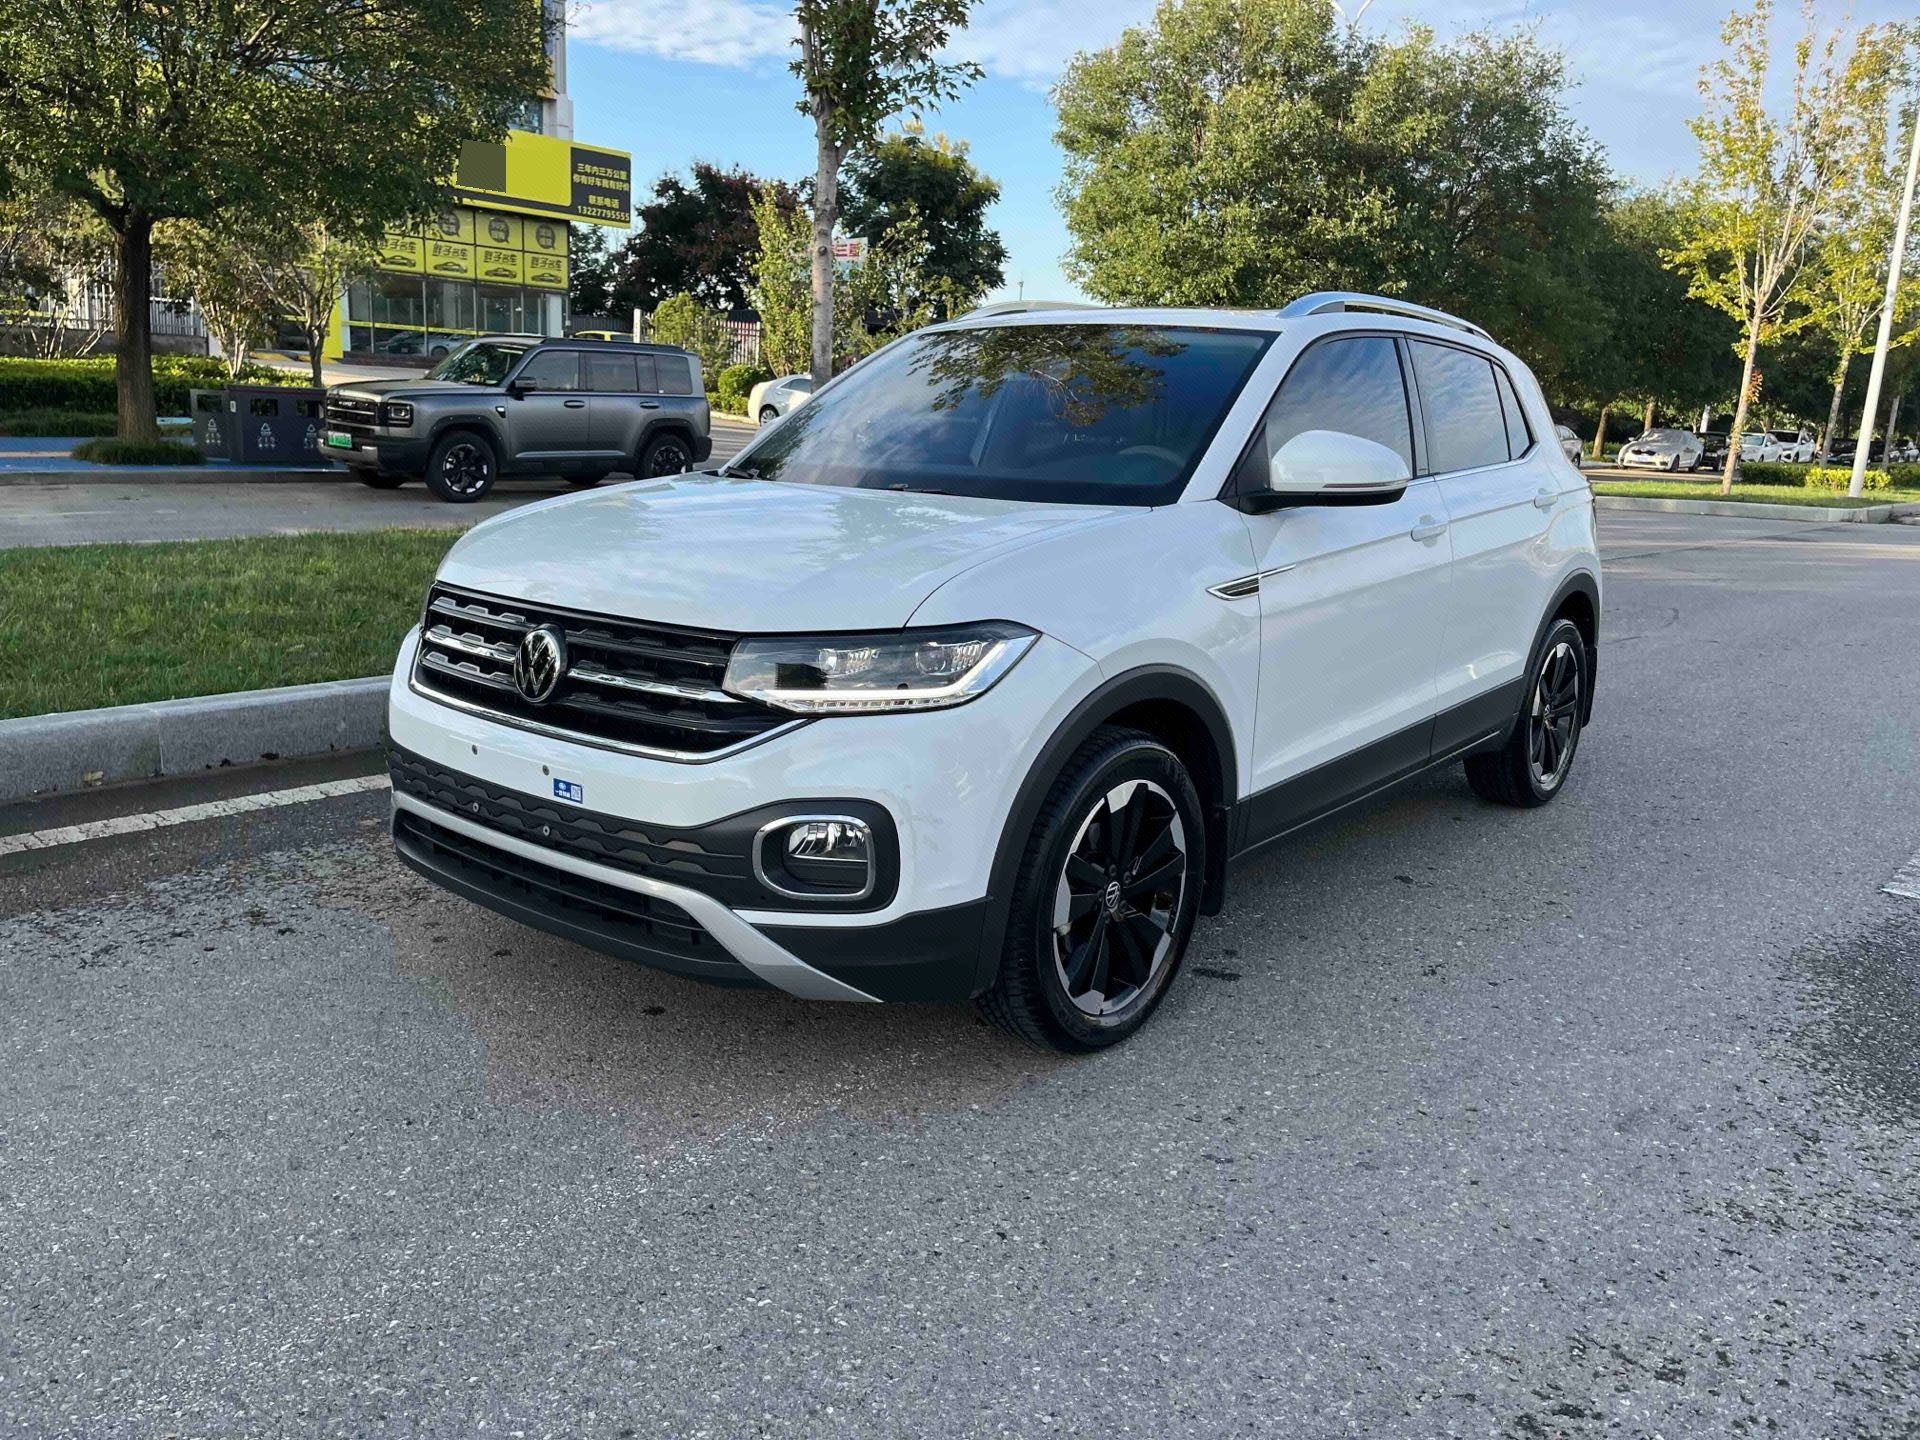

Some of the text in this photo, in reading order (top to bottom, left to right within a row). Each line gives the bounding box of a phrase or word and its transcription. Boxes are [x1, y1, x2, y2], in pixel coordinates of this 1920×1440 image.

[588, 194, 620, 209] 联系电话
[577, 205, 630, 221] 13227795555
